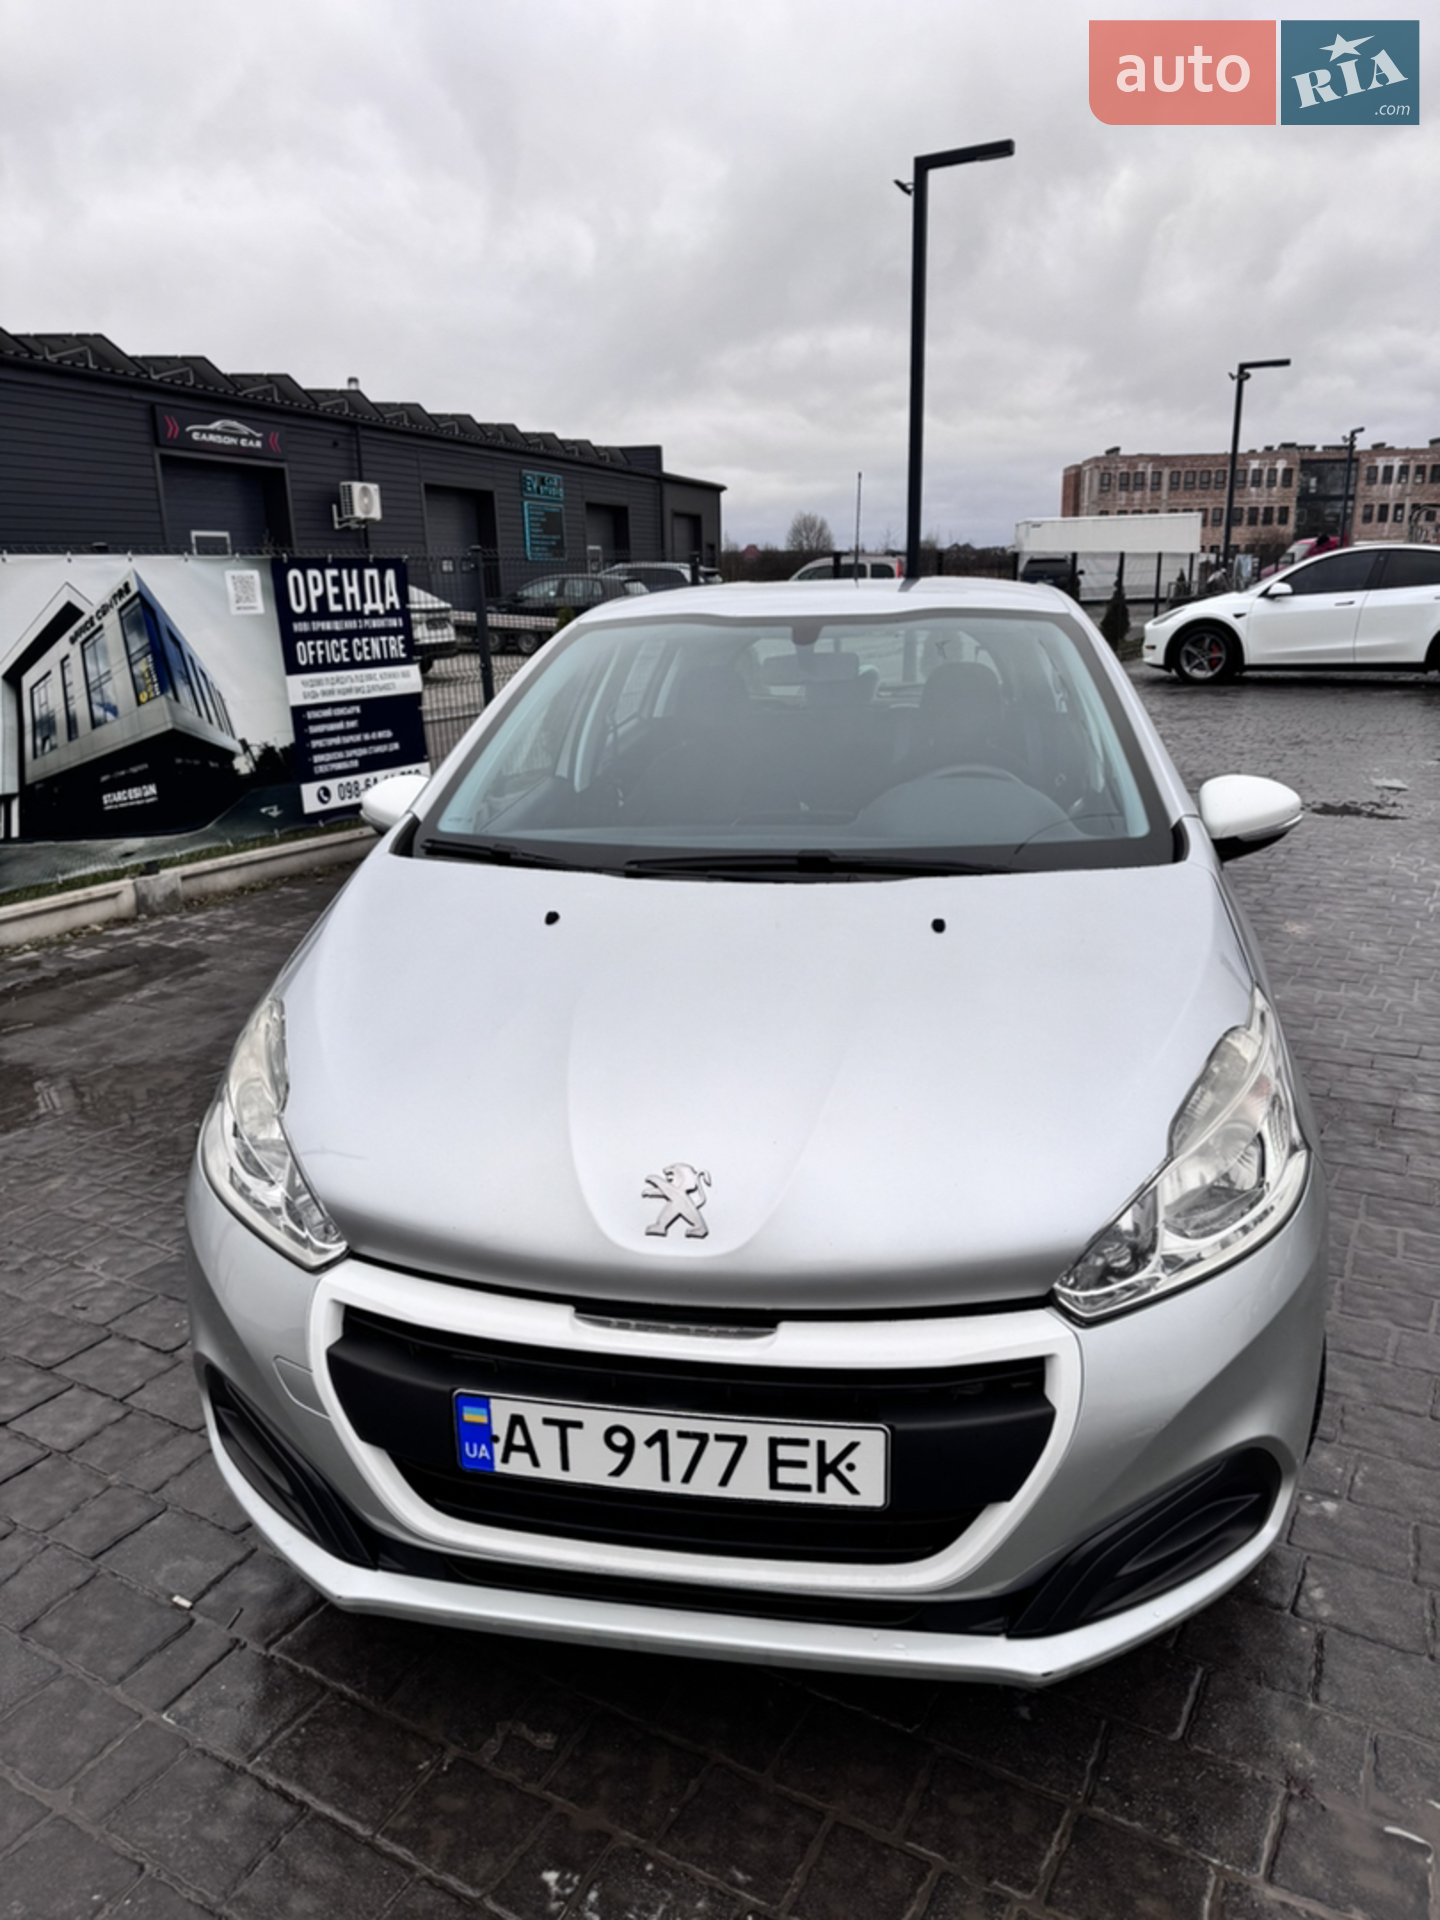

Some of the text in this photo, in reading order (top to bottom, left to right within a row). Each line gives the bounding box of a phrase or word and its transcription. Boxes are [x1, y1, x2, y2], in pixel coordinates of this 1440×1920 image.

[240, 438, 262, 449] CAR
[286, 567, 401, 616] ОРЕНДА
[296, 635, 407, 667] OFFICE CENTRE
[465, 1441, 491, 1461] UA
[500, 1413, 862, 1496] AT 9177 EK
